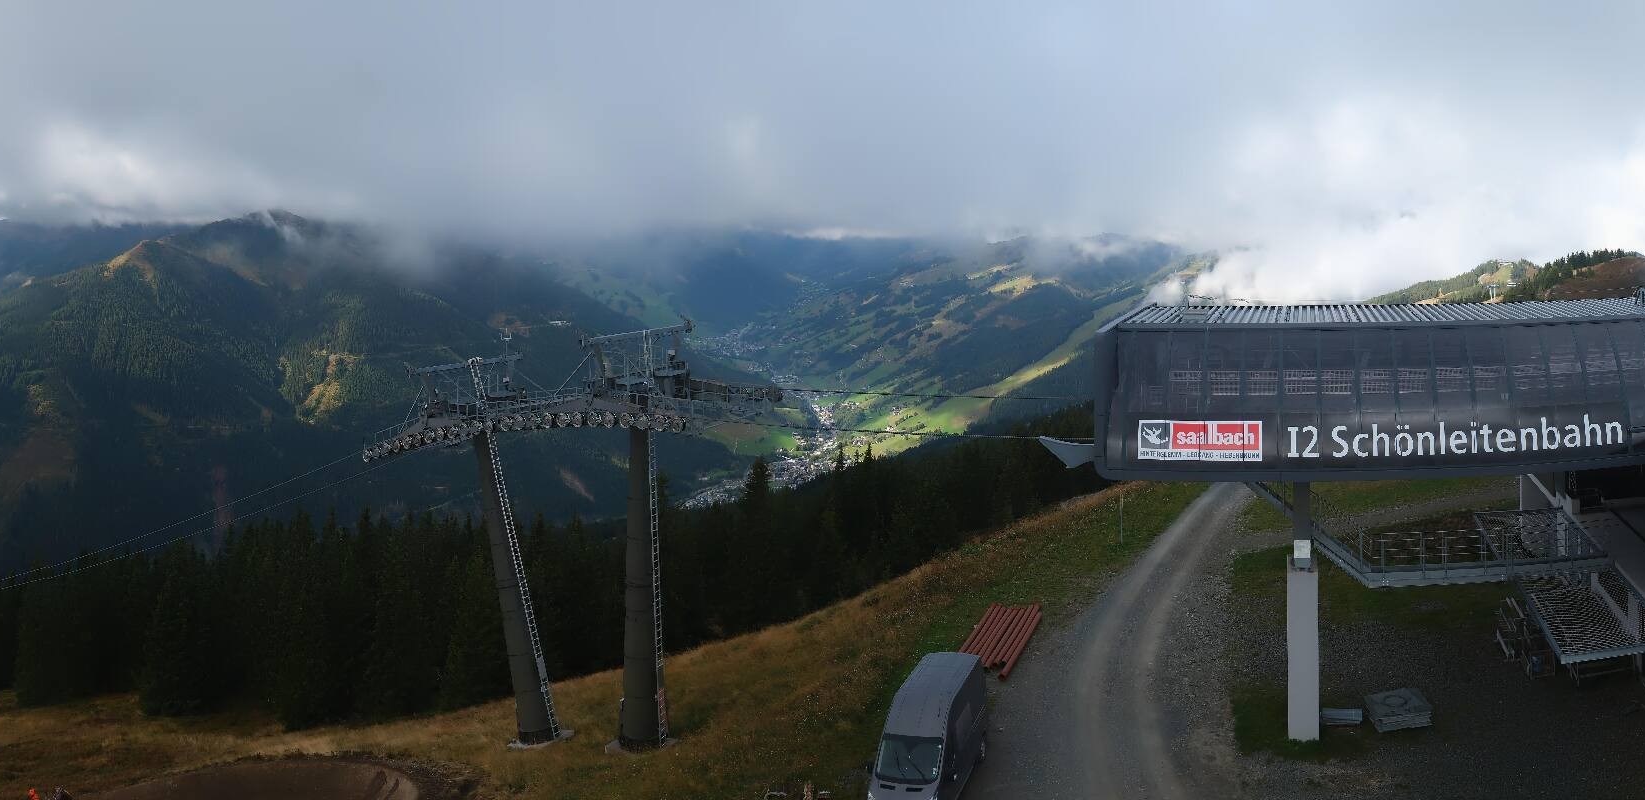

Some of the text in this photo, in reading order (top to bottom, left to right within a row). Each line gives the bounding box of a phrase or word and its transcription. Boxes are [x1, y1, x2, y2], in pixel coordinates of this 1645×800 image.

[1176, 423, 1255, 445] saalbach
[1287, 414, 1624, 458] I2 Schönleitenbahn
